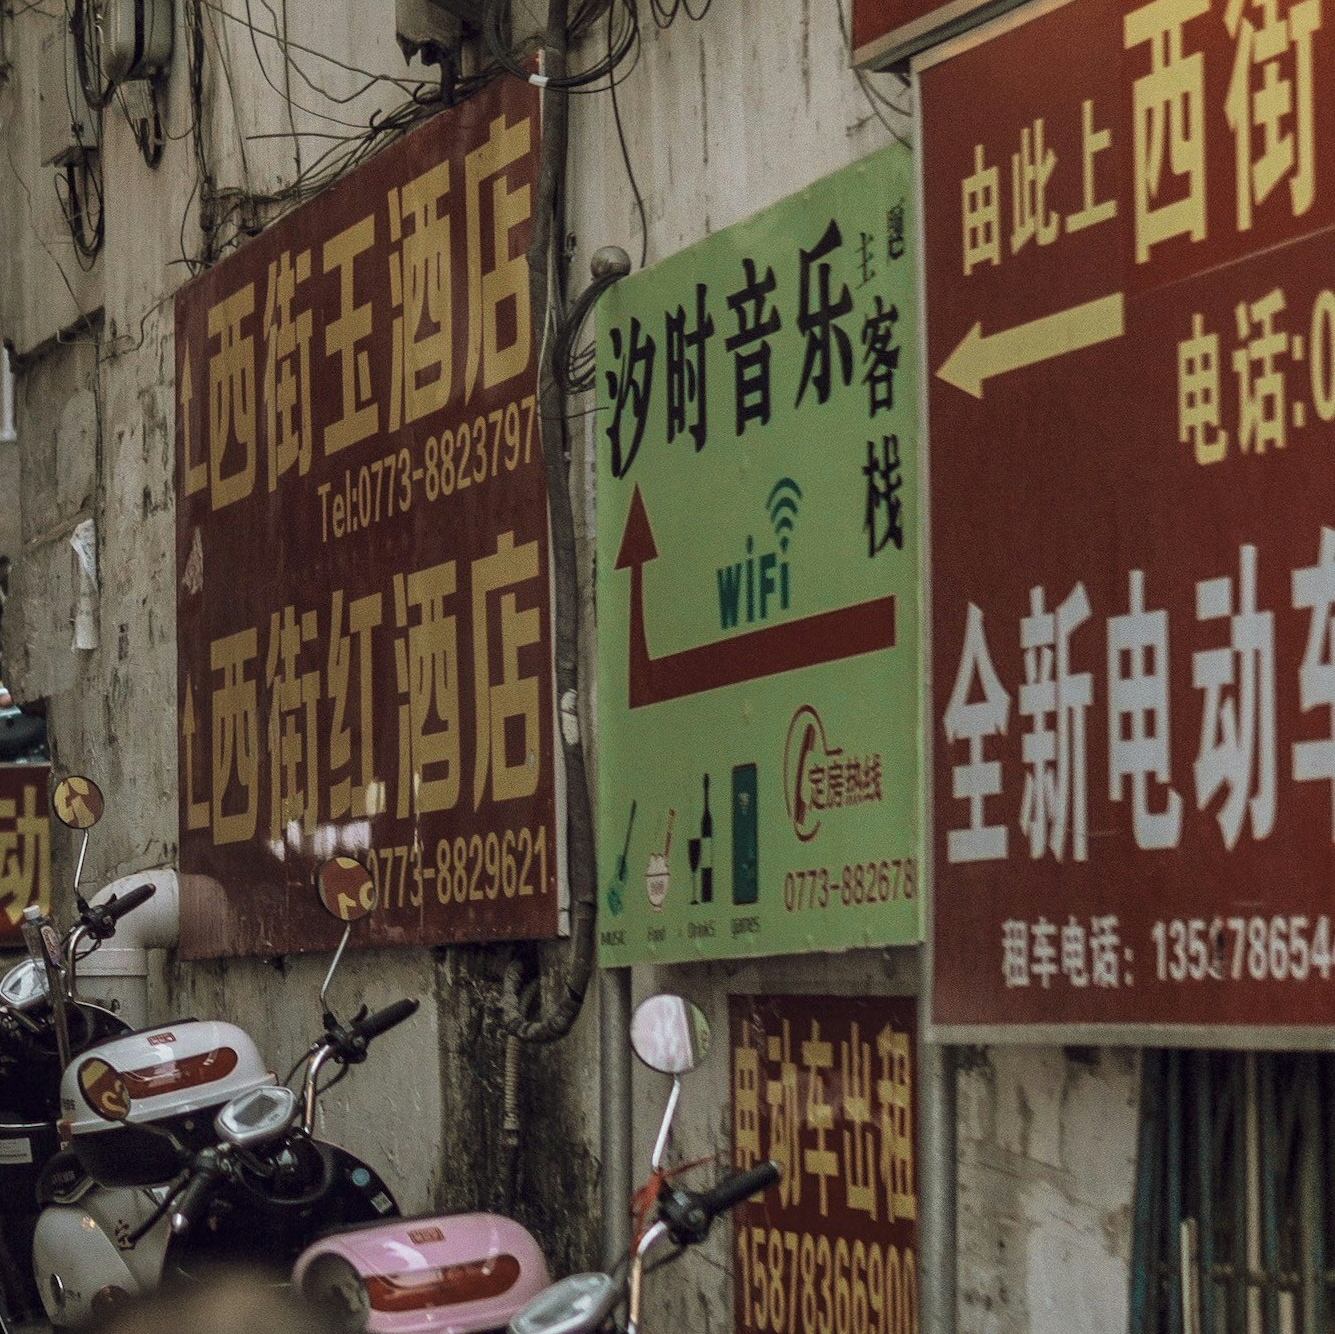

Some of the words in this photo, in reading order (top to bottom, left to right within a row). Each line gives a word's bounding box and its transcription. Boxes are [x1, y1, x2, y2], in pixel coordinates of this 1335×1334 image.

[207, 111, 533, 513] 西街玉酒店
[317, 393, 535, 545] Tel:0773-8823797
[210, 529, 542, 845] 西街红酒店
[943, 527, 1335, 864] 全新电动车
[735, 1017, 917, 1222] 电动车出租
